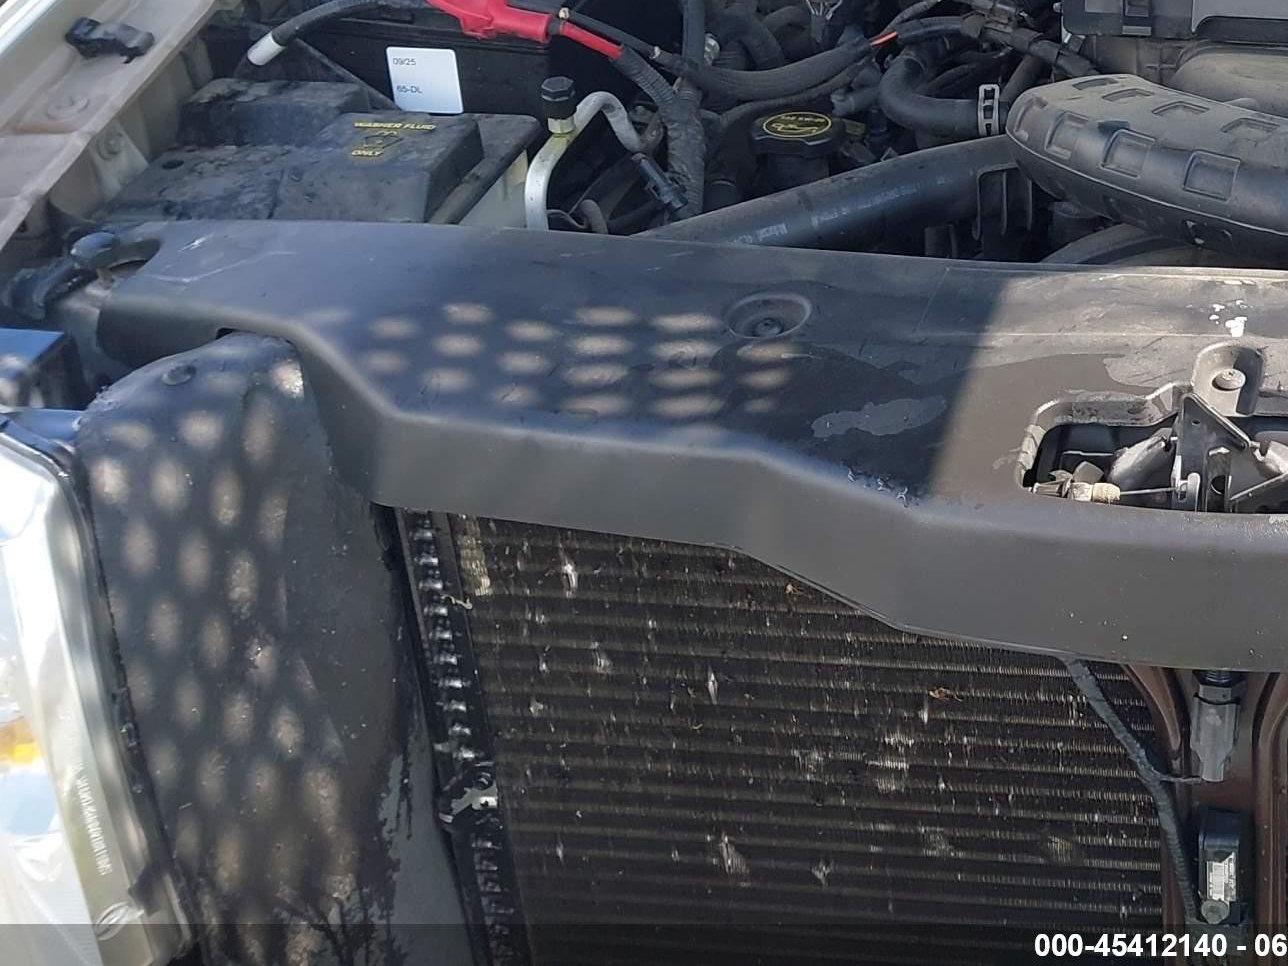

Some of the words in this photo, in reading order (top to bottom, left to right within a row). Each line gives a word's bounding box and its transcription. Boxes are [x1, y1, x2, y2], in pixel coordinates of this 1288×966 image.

[392, 57, 417, 66] 09/25
[396, 85, 423, 94] 65-DL
[403, 122, 437, 131] FLUID
[351, 149, 384, 157] ONLY
